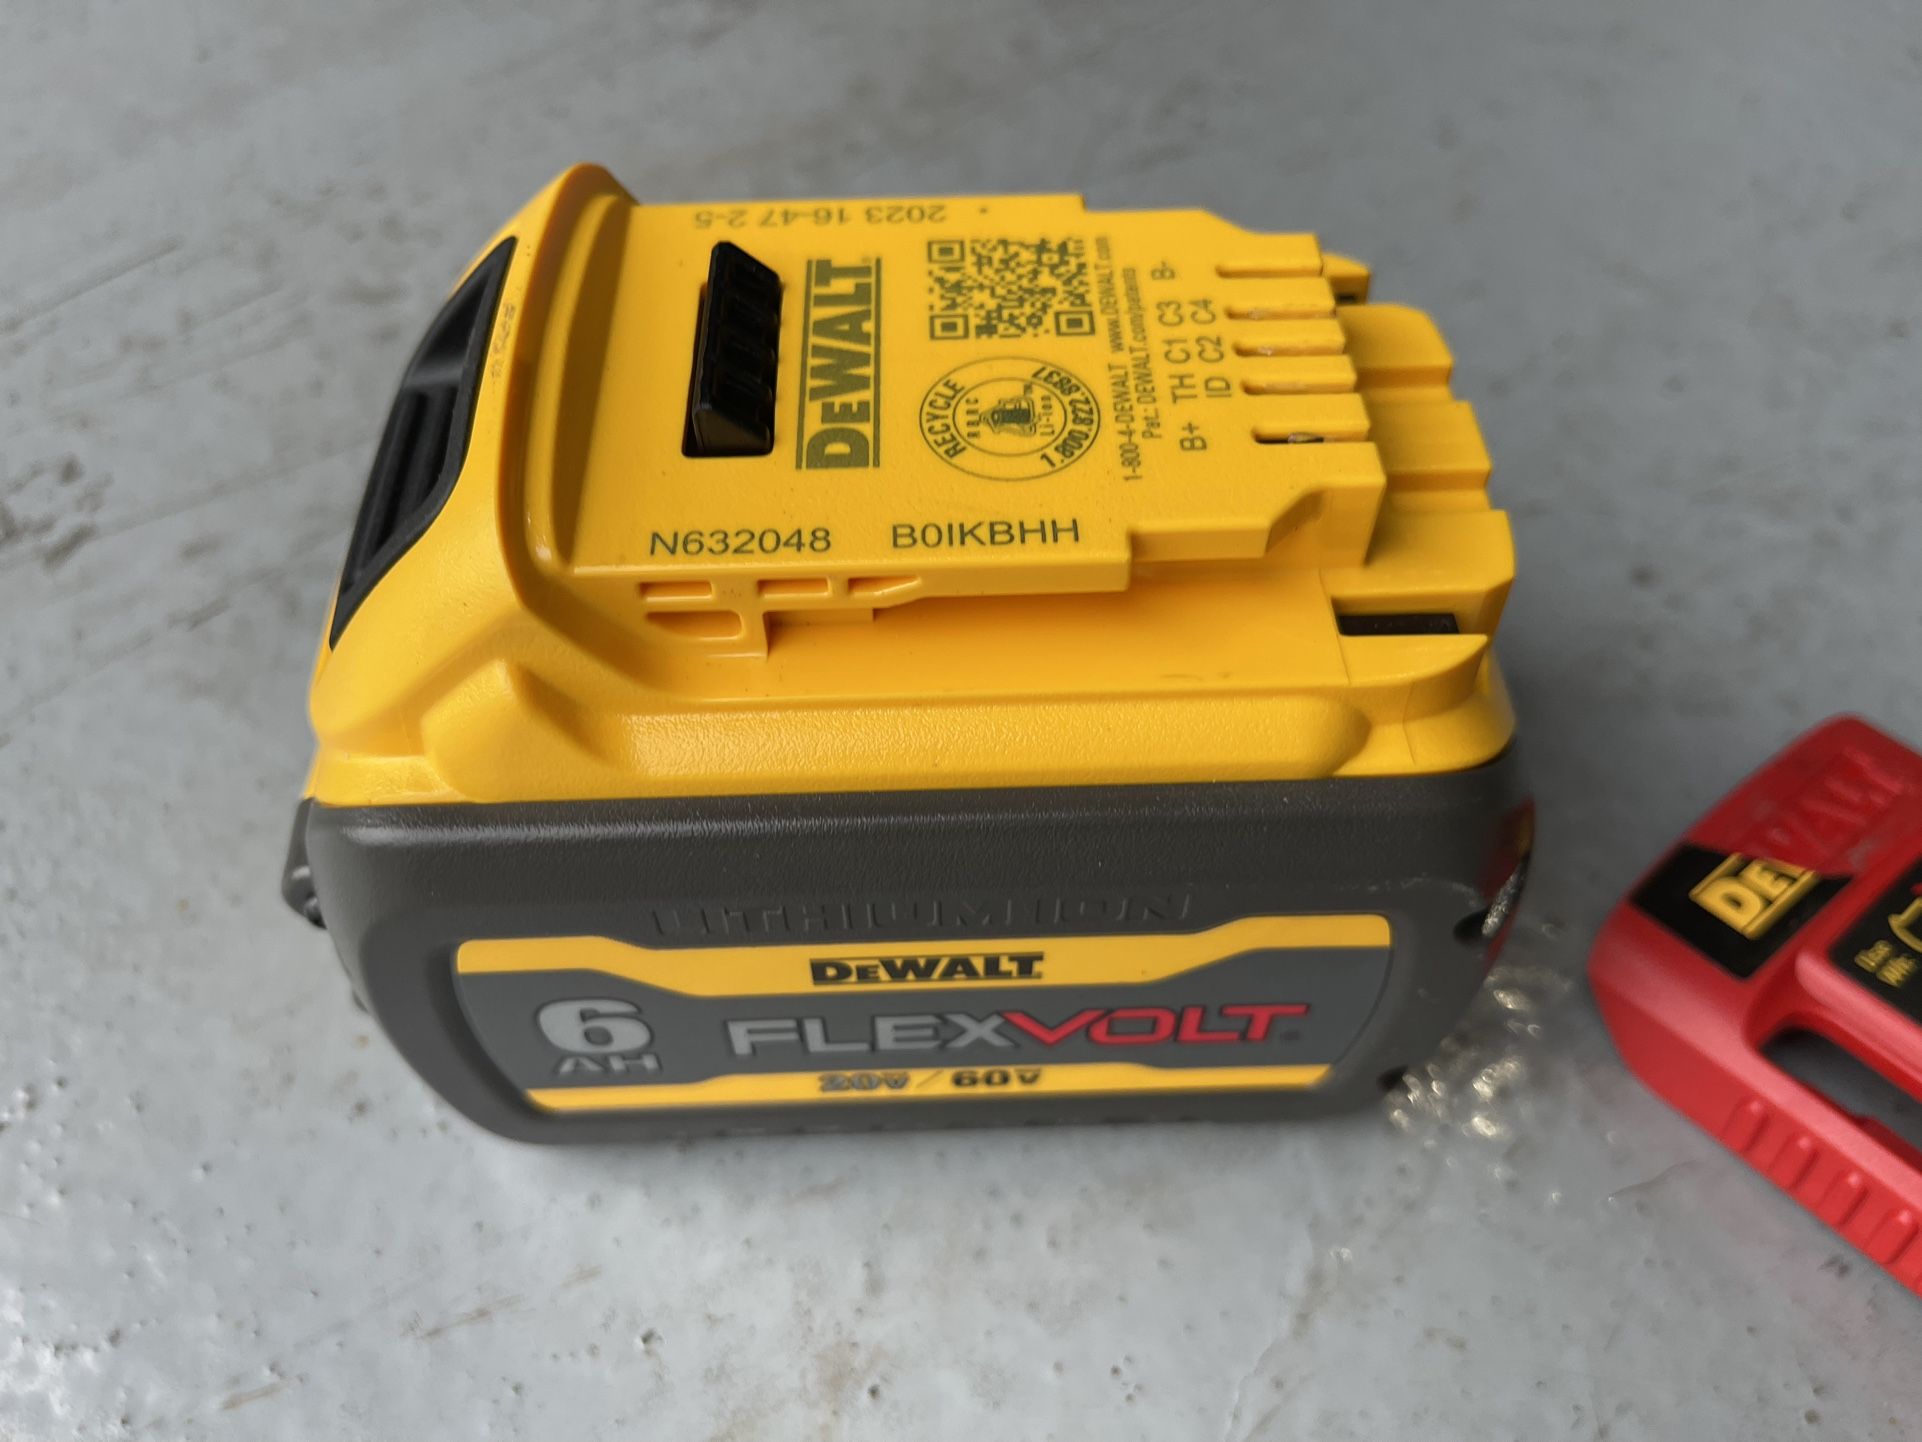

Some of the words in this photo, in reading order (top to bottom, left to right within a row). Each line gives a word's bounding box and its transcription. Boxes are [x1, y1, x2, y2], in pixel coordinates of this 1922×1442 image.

[694, 208, 748, 230] 2-5
[758, 206, 851, 228] 16-47
[864, 205, 947, 225] 2023
[1157, 300, 1184, 327] C3
[1190, 298, 1217, 325] C4
[1164, 337, 1191, 364] C1
[1198, 336, 1225, 363] C2
[805, 259, 872, 469] DEWALT
[1169, 373, 1197, 404] TH
[1204, 376, 1232, 398] ID
[925, 378, 967, 459] RECYCLE
[1108, 362, 1143, 481] 1-800-4-DEWALT
[1179, 421, 1207, 451] B+
[649, 527, 832, 556] N632048
[810, 951, 1045, 986] DEWALT
[535, 998, 652, 1055] 6
[725, 1002, 1310, 1057] FLEXVOLT
[554, 1053, 662, 1076] AH
